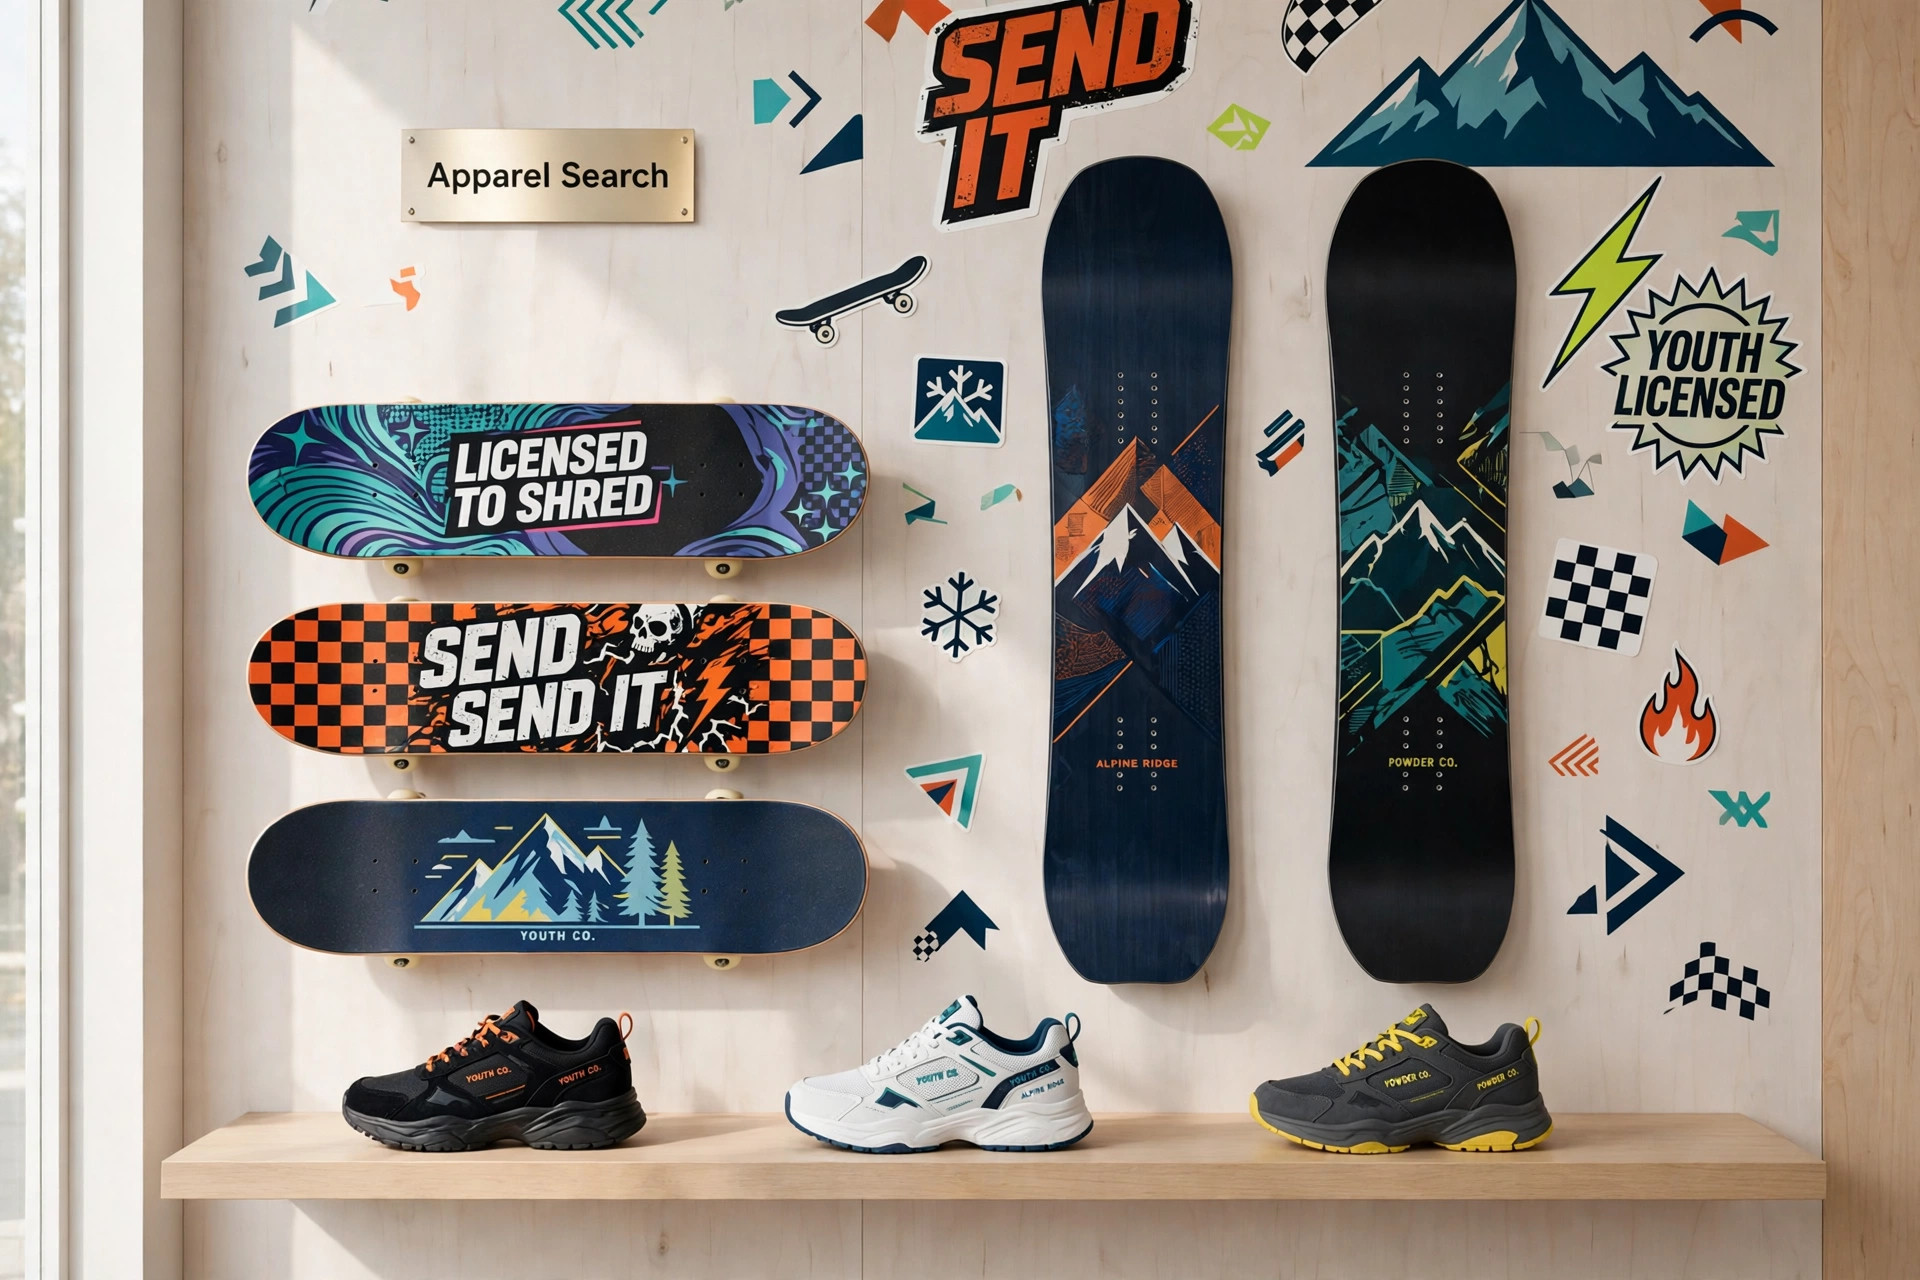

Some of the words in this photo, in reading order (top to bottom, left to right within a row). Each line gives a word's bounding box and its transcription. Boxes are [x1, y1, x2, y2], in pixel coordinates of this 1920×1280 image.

[933, 0, 1181, 118] SEND
[427, 161, 550, 195] Apparel
[561, 161, 669, 189] Search
[953, 105, 1051, 209] IT
[1648, 330, 1765, 373] YOUTH
[1614, 375, 1786, 420] LICENSED
[454, 430, 648, 483] LICENSED
[454, 484, 507, 528] TO
[516, 474, 654, 523] SHRED
[419, 613, 582, 689] SEND
[447, 678, 596, 748] SEND
[609, 670, 668, 733] IT
[1096, 759, 1138, 768] ALPINE
[1142, 759, 1178, 768] RIDGE
[1388, 757, 1435, 768] POWDER
[1439, 757, 1458, 768] CO.
[520, 930, 566, 941] YOUTH
[572, 930, 596, 941] CO.
[465, 1069, 495, 1083] YOUTH
[496, 1066, 512, 1076] CO.
[558, 1069, 586, 1086] YOUTH
[587, 1064, 602, 1075] CO.
